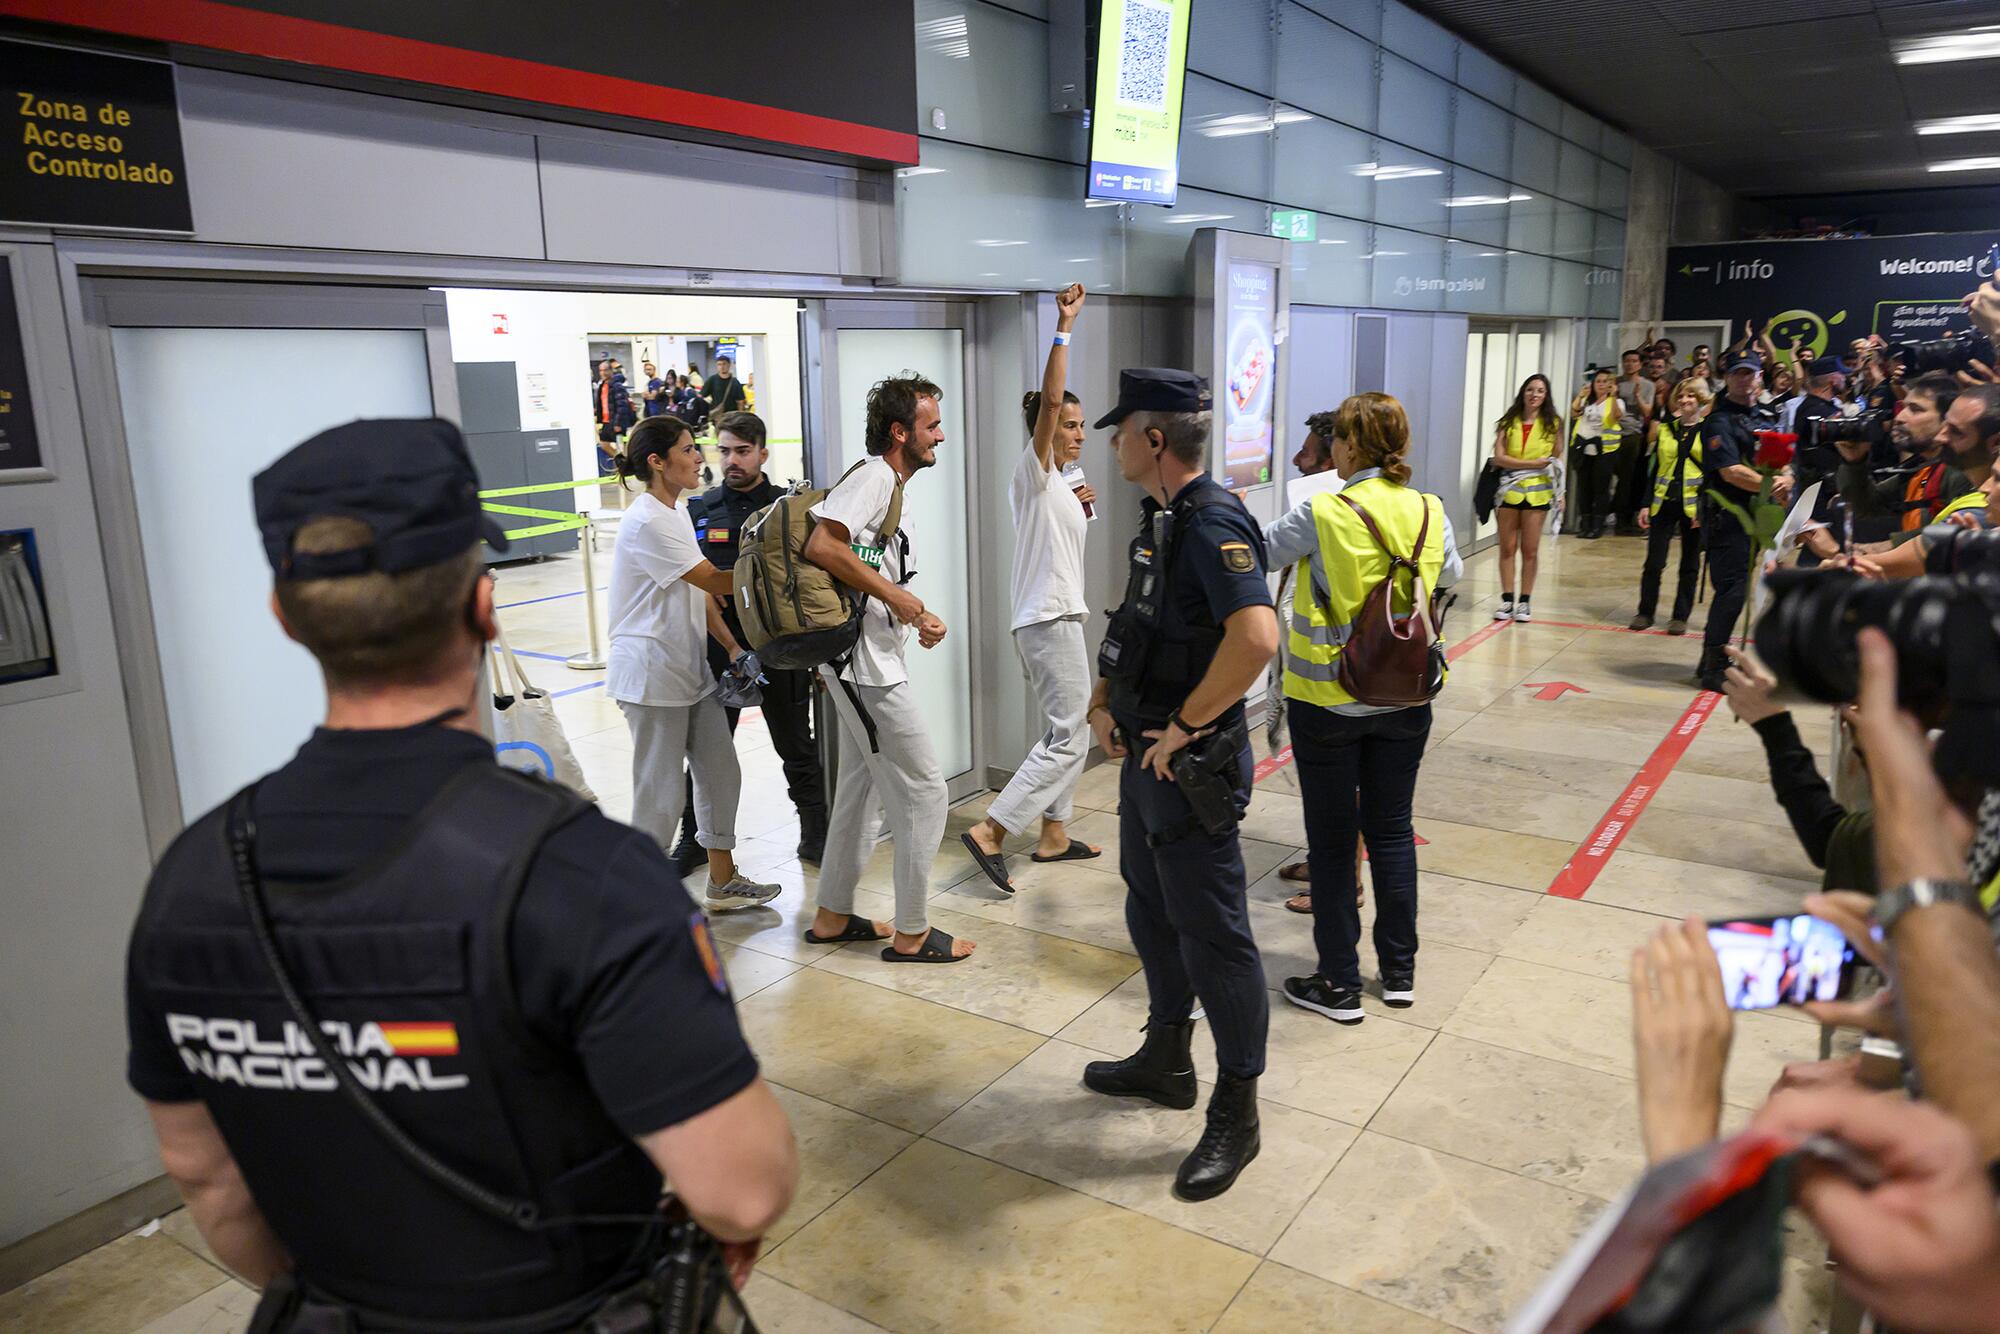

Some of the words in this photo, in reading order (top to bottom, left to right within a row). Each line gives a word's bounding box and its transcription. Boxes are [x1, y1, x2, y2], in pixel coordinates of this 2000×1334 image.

[17, 92, 88, 122] Zona
[98, 103, 131, 127] de
[23, 122, 123, 153] Acceso
[27, 151, 175, 185] Controlado
[1728, 258, 1774, 280] info
[1880, 255, 1974, 275] Welcome!
[165, 1012, 396, 1057] POLICIA
[178, 1046, 469, 1091] NACIONAL
